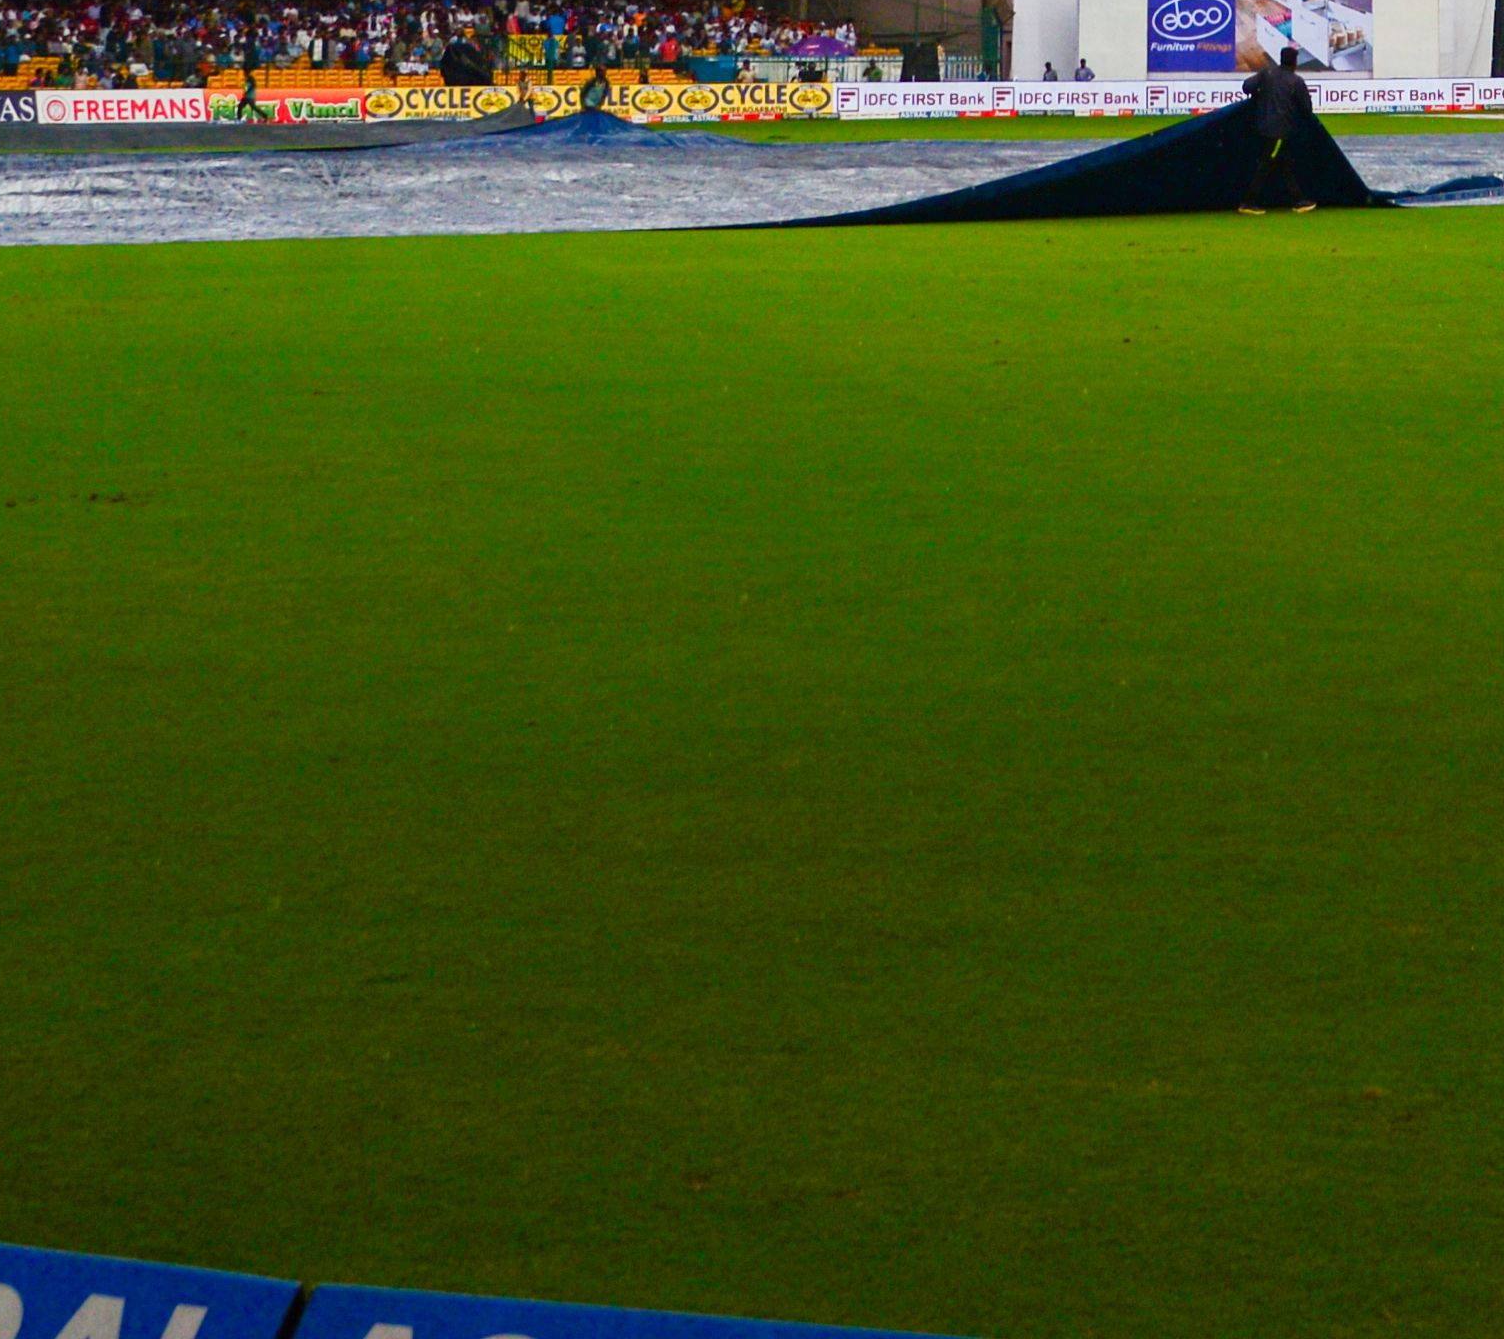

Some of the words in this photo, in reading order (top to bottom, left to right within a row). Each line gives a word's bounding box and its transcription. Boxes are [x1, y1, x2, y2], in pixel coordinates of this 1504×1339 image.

[1163, 1, 1222, 31] ebco
[1150, 42, 1195, 52] Furniture
[73, 96, 200, 121] FREEMANS
[405, 88, 472, 109] CYCLE
[863, 92, 898, 107] IDFC
[903, 92, 945, 106] FIRST
[950, 91, 985, 106] Bank
